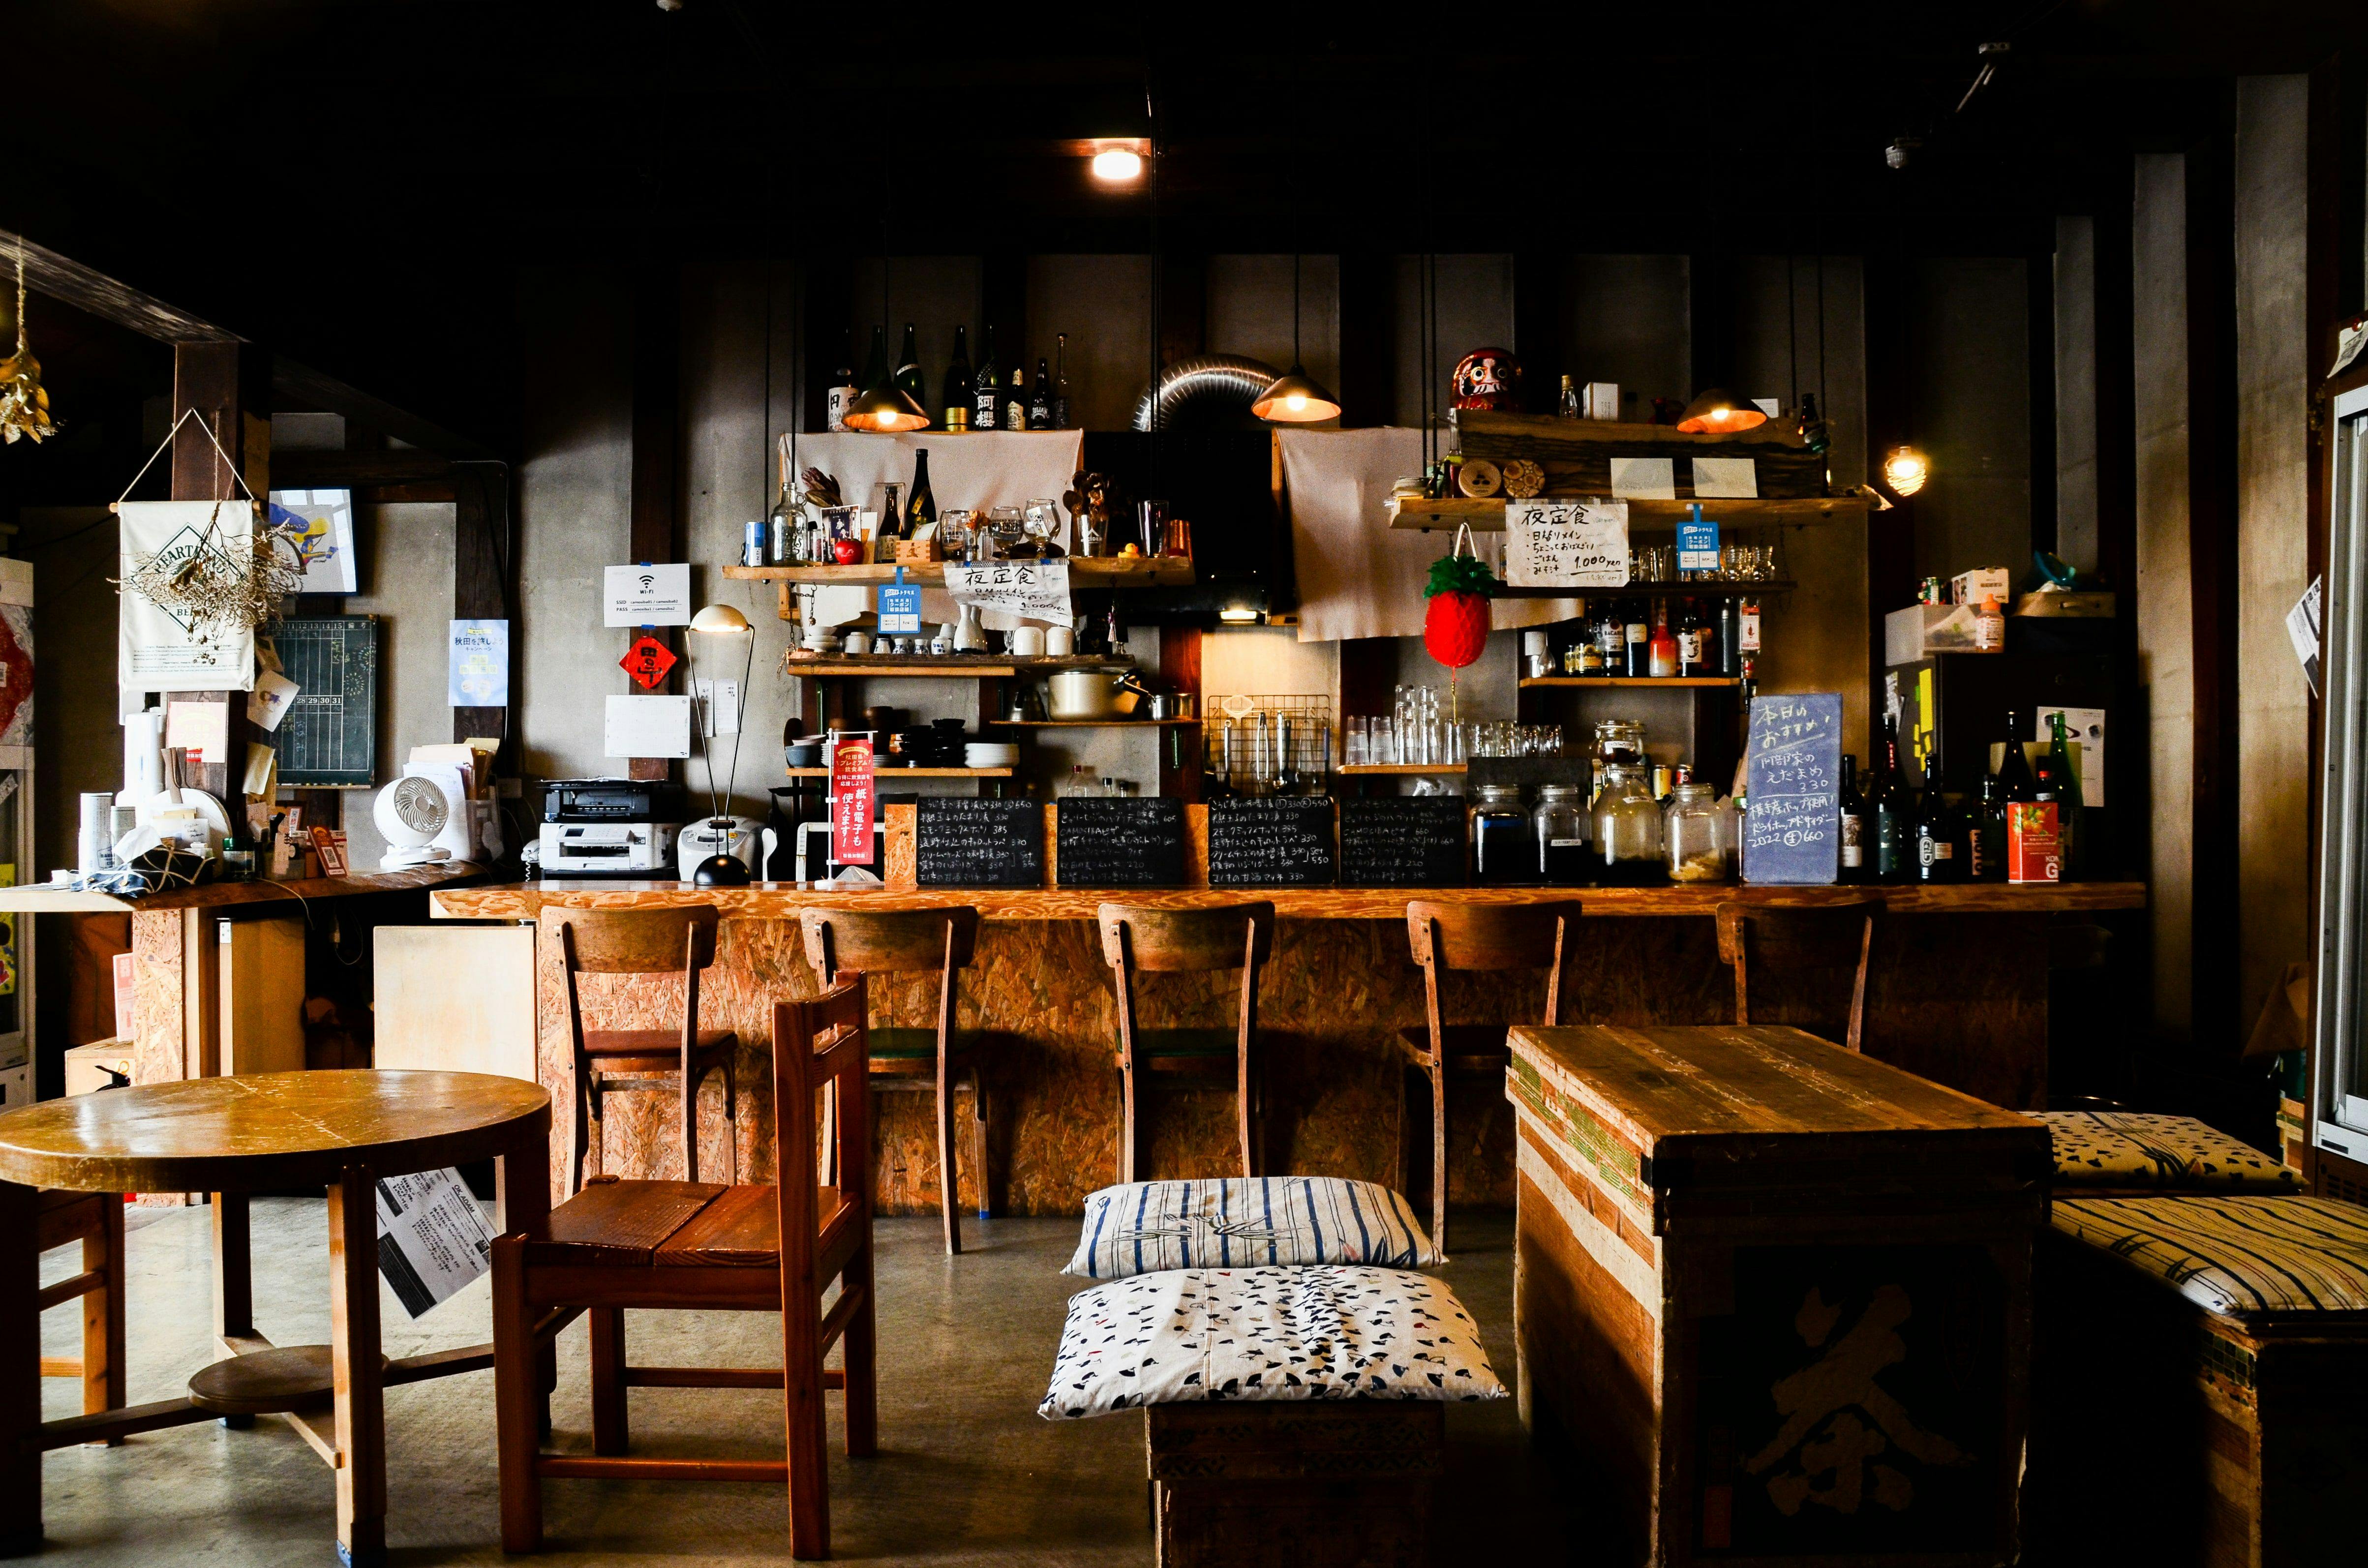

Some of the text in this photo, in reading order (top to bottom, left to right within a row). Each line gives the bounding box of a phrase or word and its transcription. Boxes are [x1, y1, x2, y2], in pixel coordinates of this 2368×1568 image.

[1522, 505, 1590, 526] 夜定食
[1533, 530, 1581, 541] 日替りメイン
[1534, 554, 1559, 565] ごはん
[965, 566, 1035, 586] 夜定食
[1534, 566, 1559, 575] みそ汁
[454, 637, 504, 646] 秋田を旅しよう
[1756, 704, 1807, 725] 本日の
[1766, 765, 1823, 784] えだまめ
[1799, 780, 1829, 792] 330
[990, 801, 1002, 809] 330
[1015, 800, 1032, 809] 550
[1287, 800, 1301, 809] 330
[840, 793, 854, 847] 使えます!
[852, 788, 867, 846] 紙も電子も
[1285, 812, 1300, 820] 330
[993, 825, 1008, 834] 385
[1281, 824, 1298, 833] 385
[1301, 834, 1317, 843] 330
[1748, 833, 1781, 847] 2022
[1803, 830, 1824, 842] 660
[1291, 847, 1305, 856] 330
[1289, 872, 1304, 880] 330
[452, 1183, 464, 1196] OK,
[459, 1194, 476, 1213] ADAM
[1738, 1282, 1979, 1517] 茶
